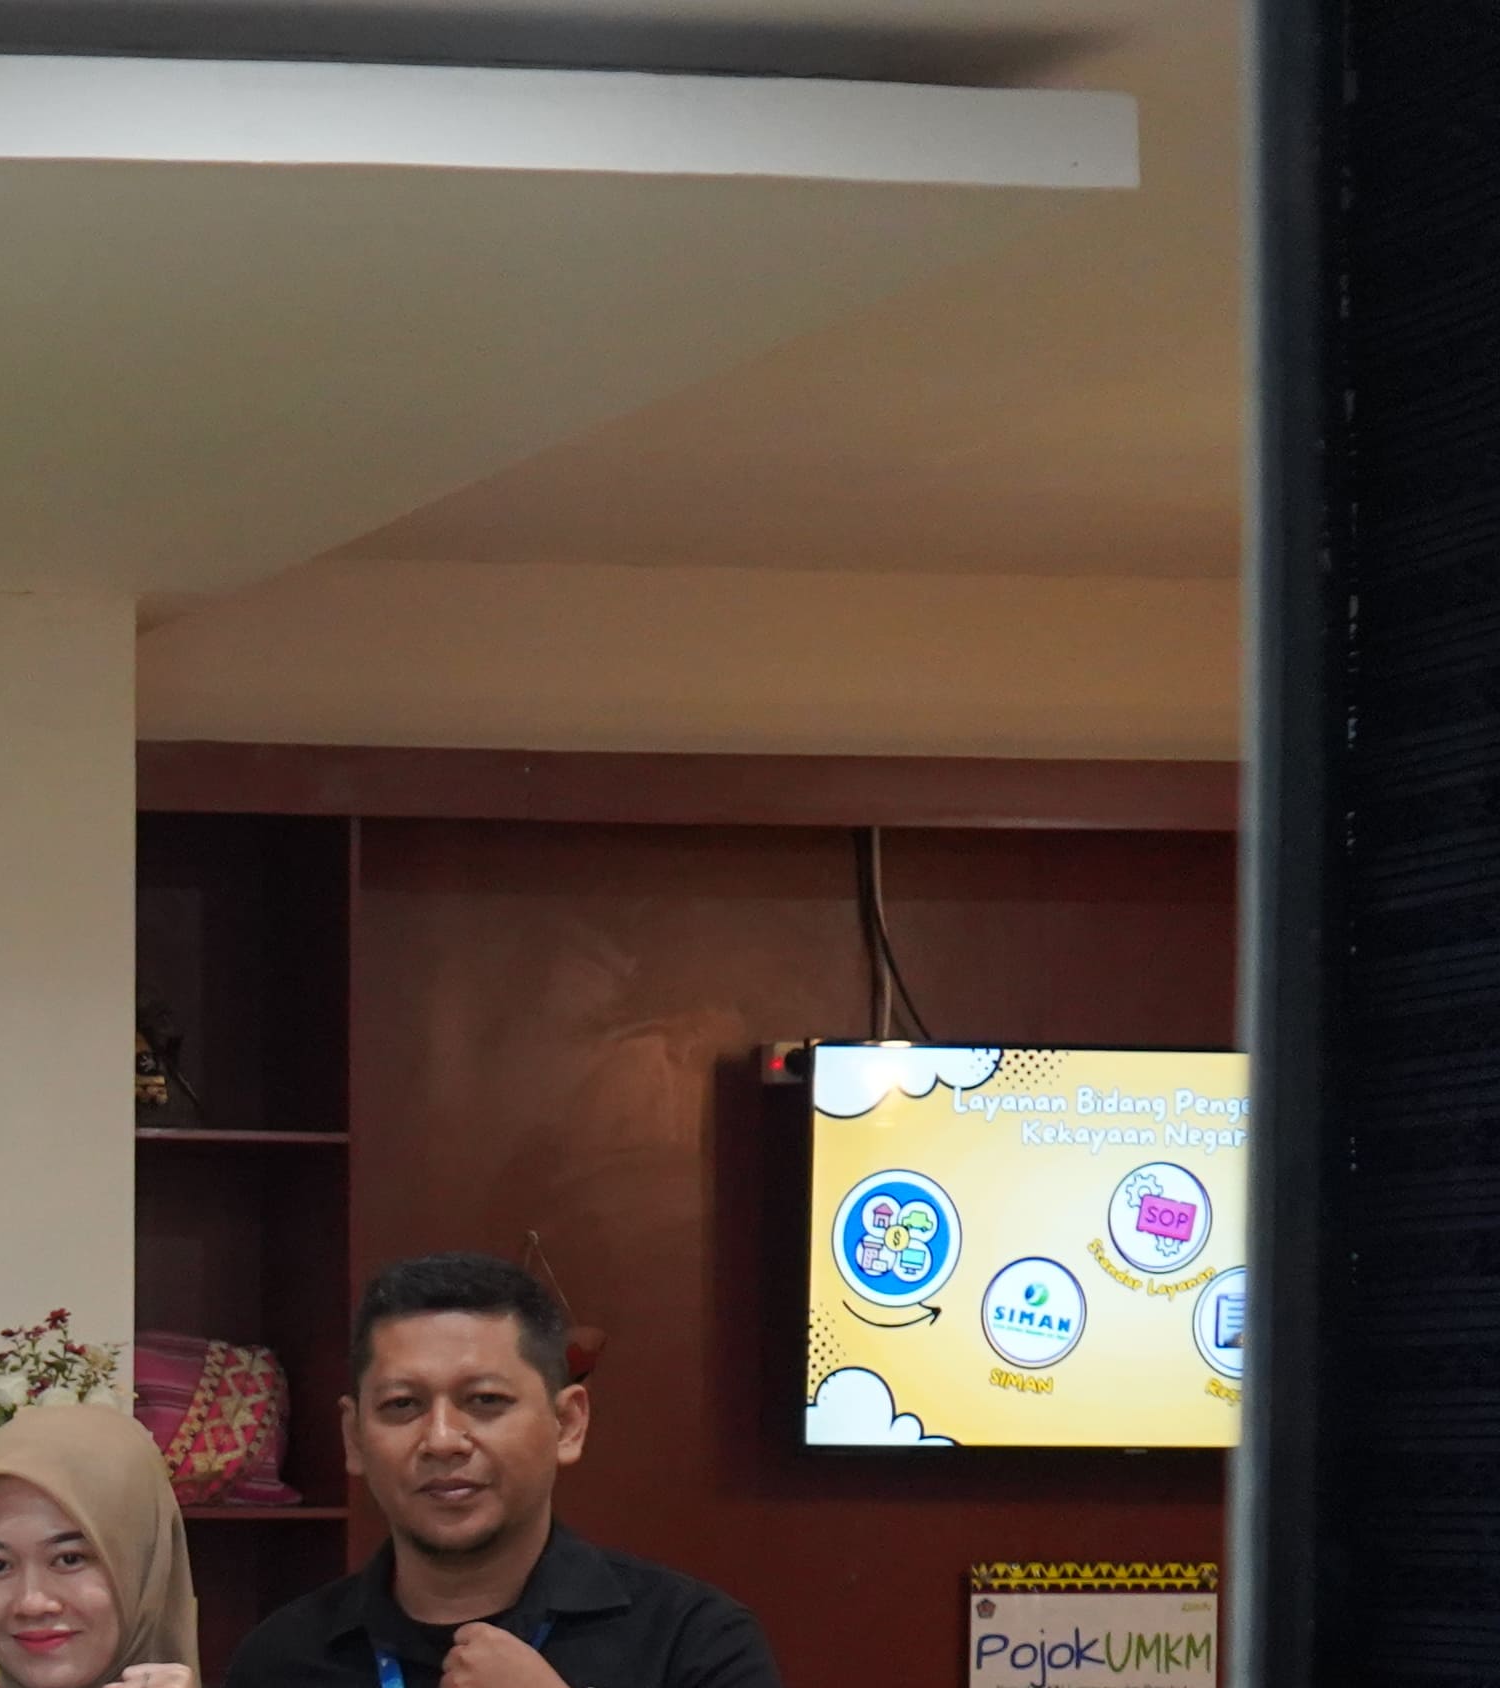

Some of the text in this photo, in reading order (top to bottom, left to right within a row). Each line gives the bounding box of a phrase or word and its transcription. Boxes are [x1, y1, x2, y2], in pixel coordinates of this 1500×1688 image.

[953, 1086, 1067, 1121] Layanan
[1076, 1086, 1166, 1122] Bidang
[1021, 1120, 1155, 1155] Kekayaan
[1145, 1206, 1189, 1229] SOP
[1087, 1239, 1216, 1302] Standar Layanan
[993, 1306, 1071, 1332] SIMAN
[989, 1367, 1054, 1395] SIMAN
